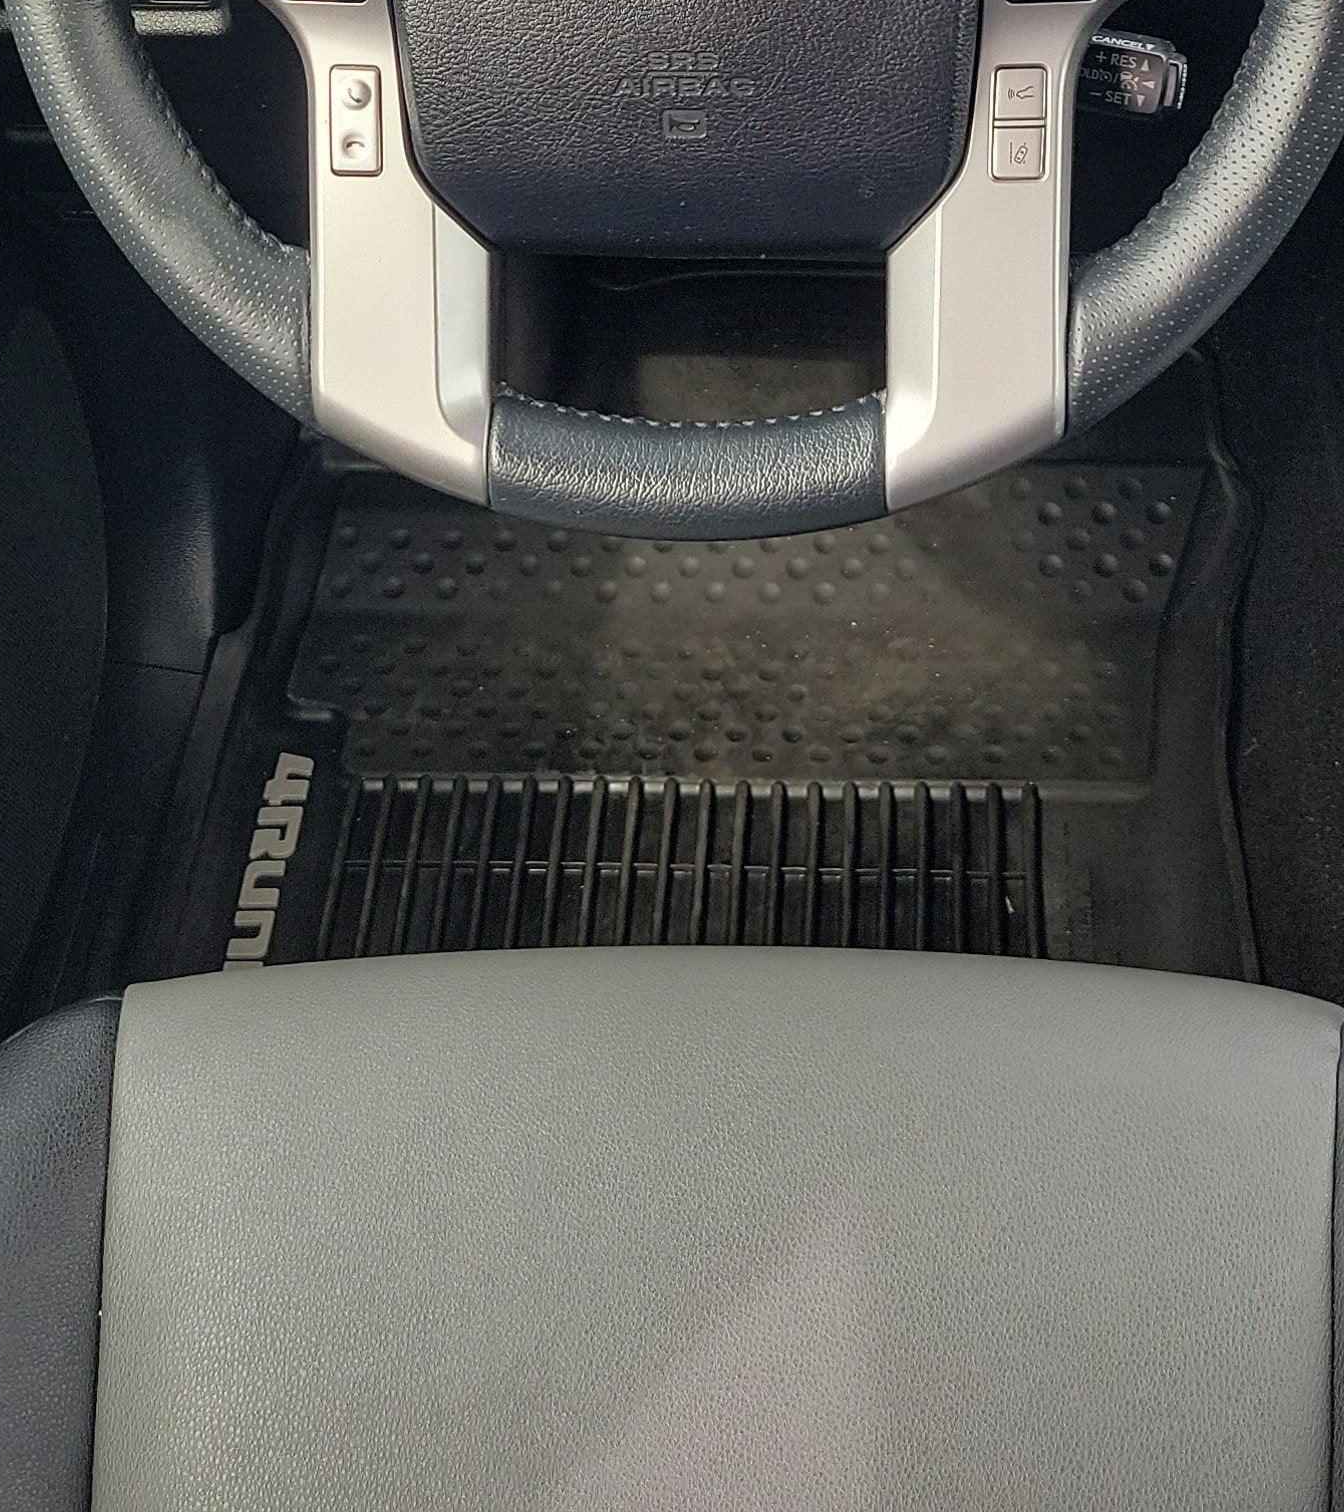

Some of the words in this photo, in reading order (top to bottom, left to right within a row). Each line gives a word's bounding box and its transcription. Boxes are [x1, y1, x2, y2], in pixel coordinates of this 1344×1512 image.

[1092, 35, 1147, 50] CANCEL
[646, 50, 719, 71] SRS
[1110, 53, 1137, 68] RES
[617, 77, 755, 99] AIRBAG
[1106, 91, 1132, 106] SET
[223, 751, 315, 971] 4RUN
